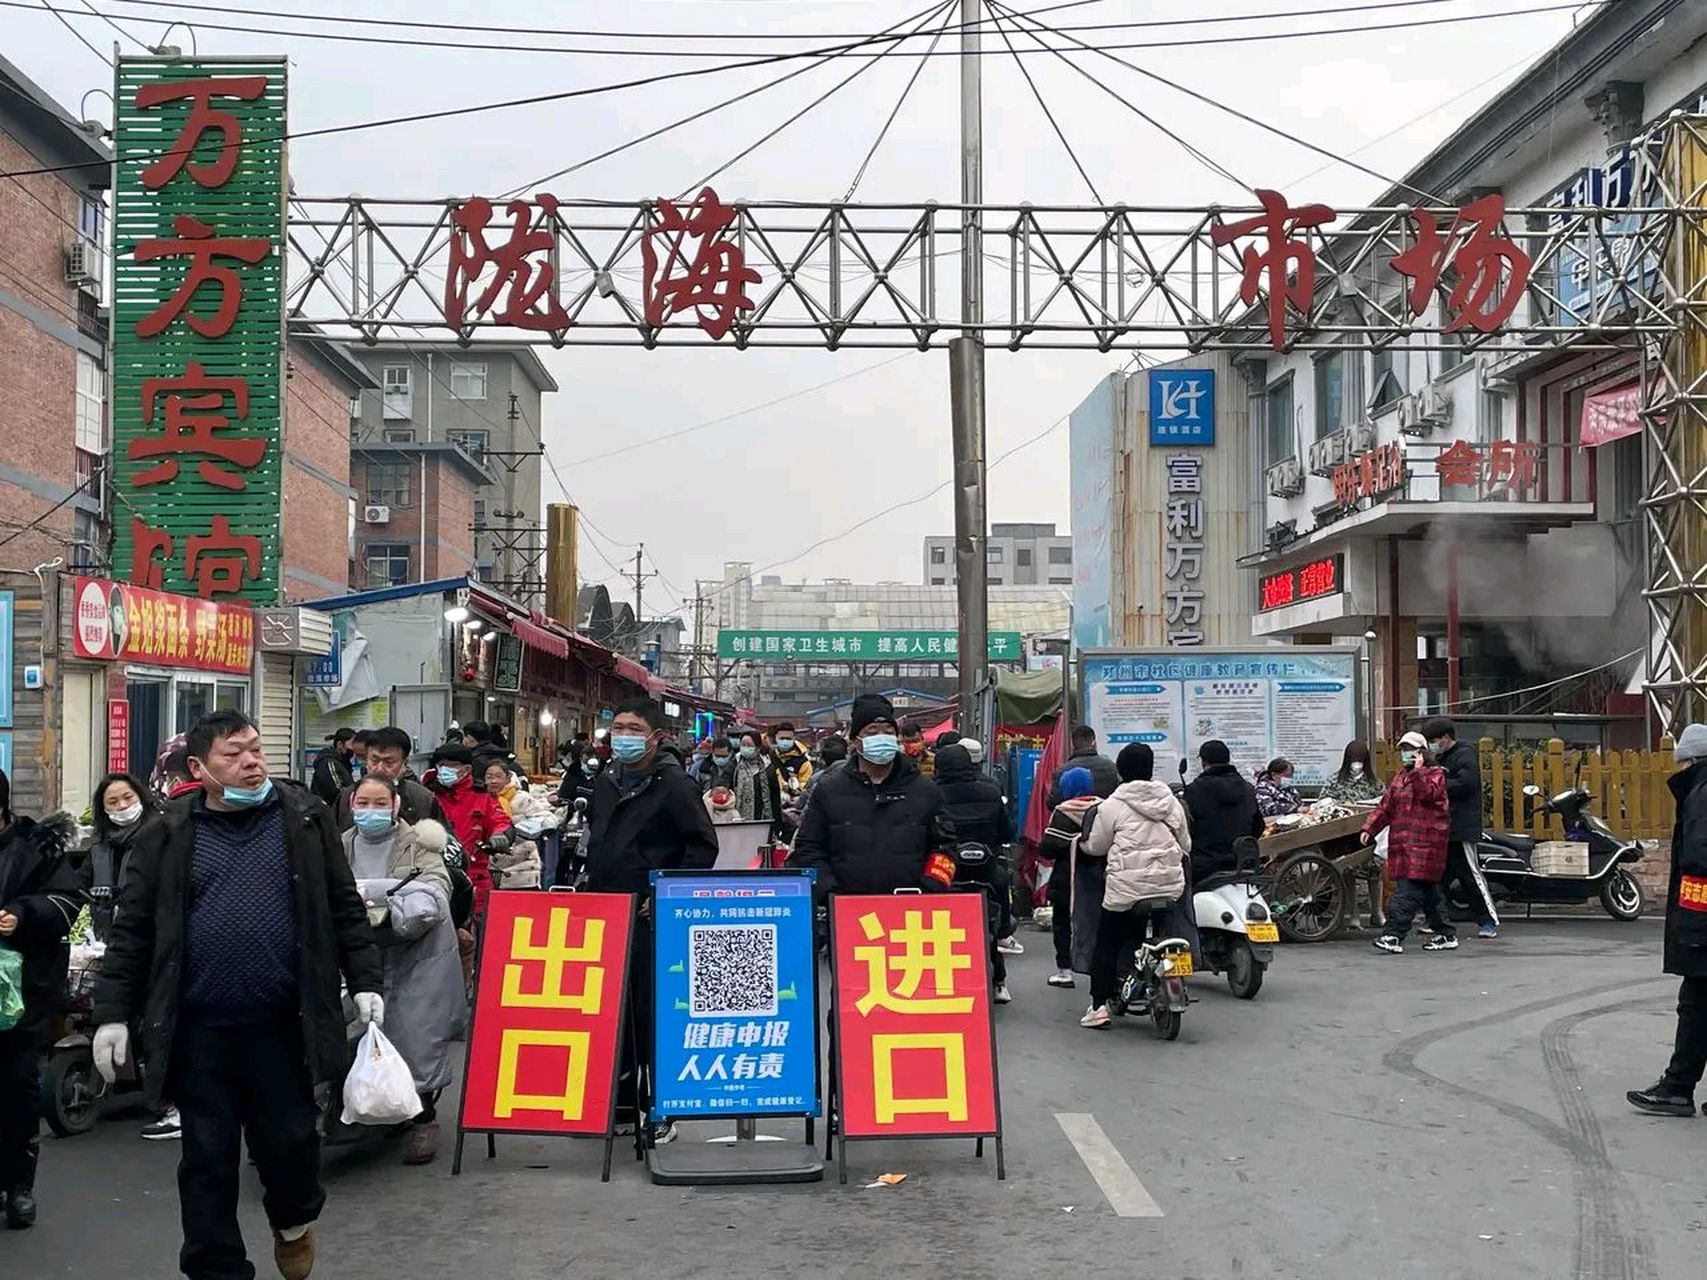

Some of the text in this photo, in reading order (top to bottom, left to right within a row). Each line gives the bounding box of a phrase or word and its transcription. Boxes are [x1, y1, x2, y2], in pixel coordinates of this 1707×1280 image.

[444, 186, 1534, 351] 陇海 市场
[127, 76, 271, 608] 万方宾馆
[1435, 438, 1540, 492] 会所
[731, 636, 1009, 653] 创建国家卫生城市 提高人民健平
[493, 906, 607, 1121] 出口
[677, 1052, 785, 1082] 人人有责
[683, 1020, 791, 1049] 健康申报
[853, 909, 976, 1124] 进口
